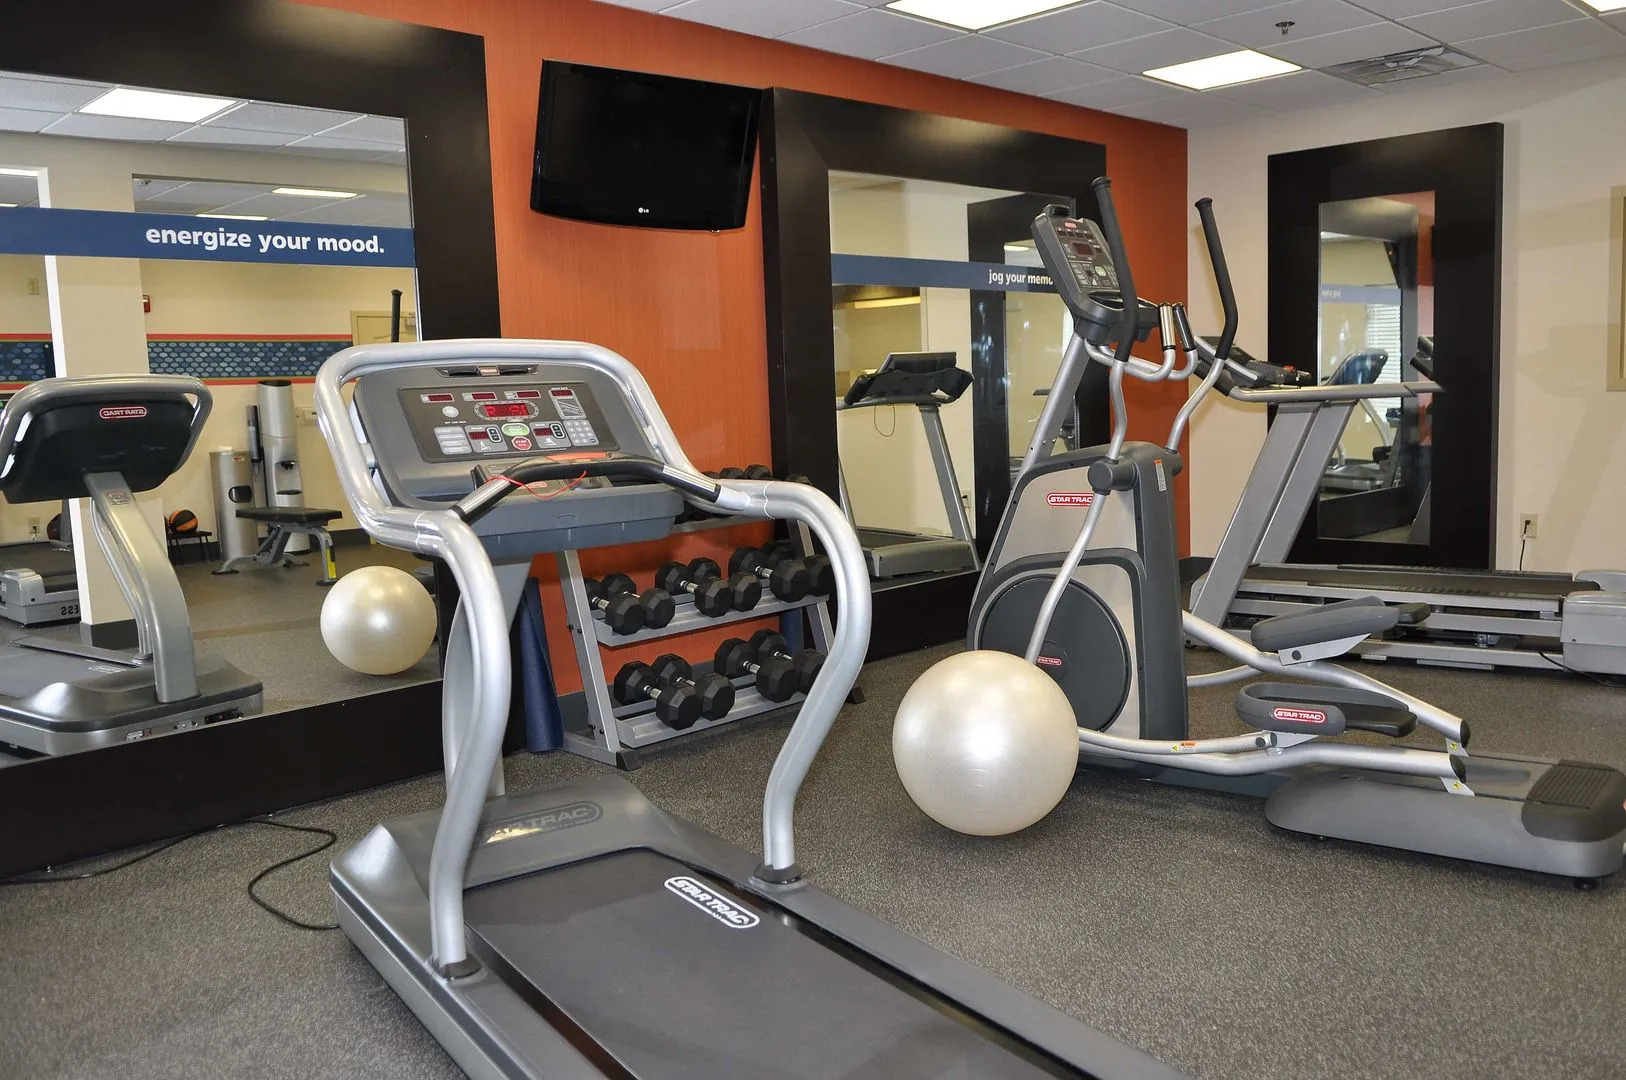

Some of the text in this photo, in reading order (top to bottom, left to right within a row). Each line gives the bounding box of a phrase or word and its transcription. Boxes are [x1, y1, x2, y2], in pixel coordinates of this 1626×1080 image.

[145, 227, 385, 253] energize your mood.
[988, 269, 1004, 285] jog
[1005, 272, 1026, 285] your
[1276, 710, 1297, 718] STAR
[526, 807, 589, 828] TRAC
[671, 879, 750, 925] STAR TRAC
